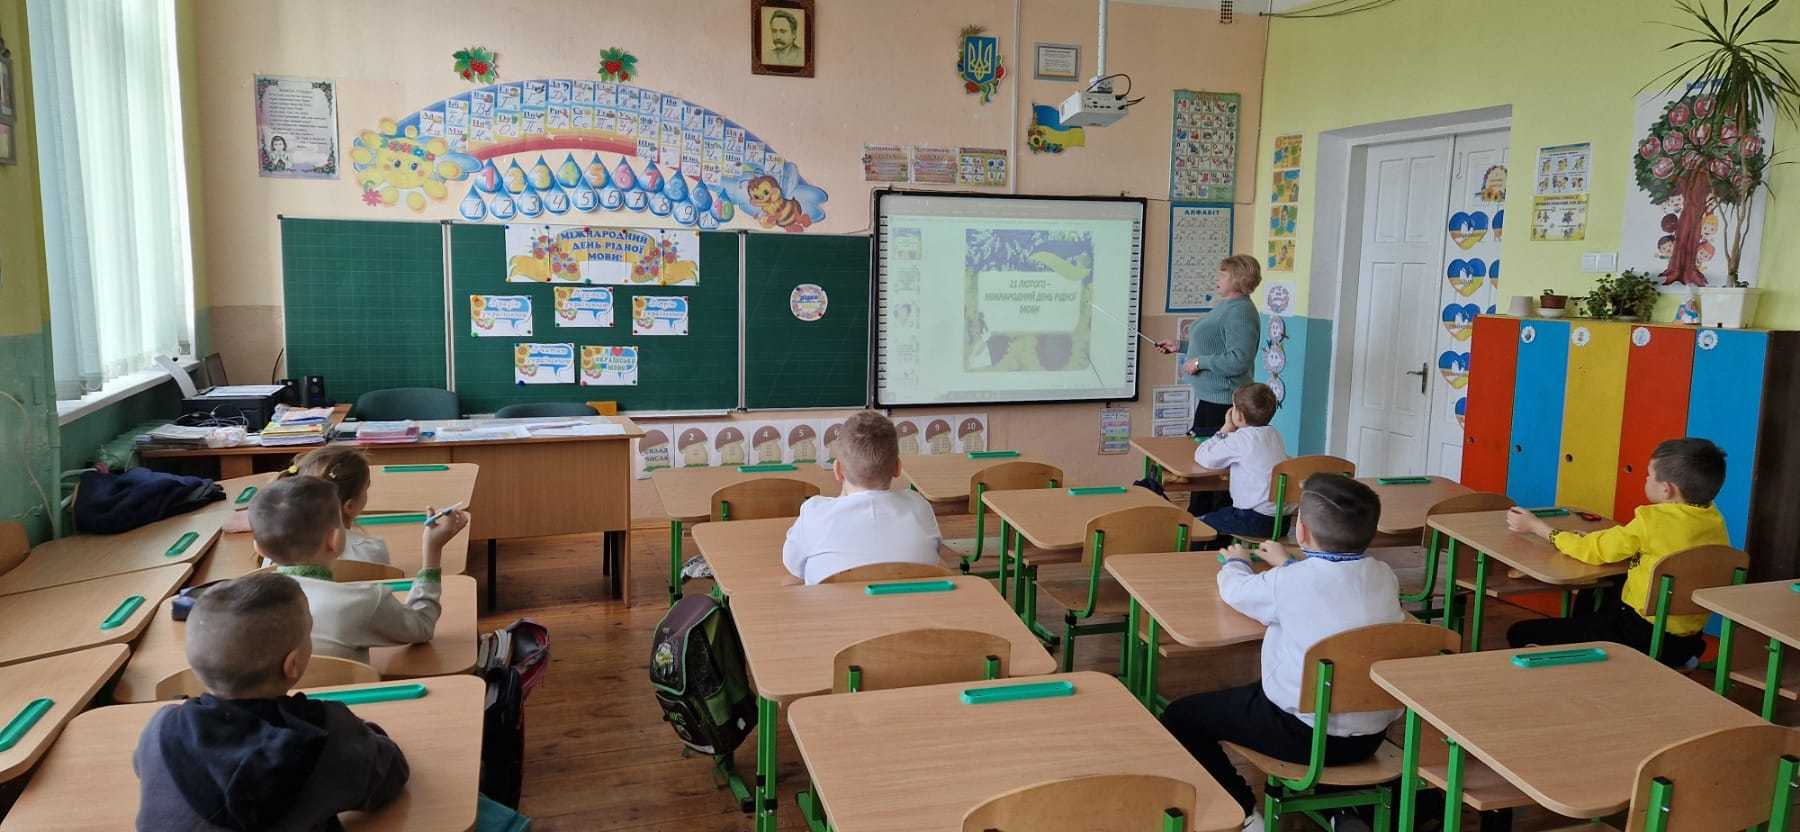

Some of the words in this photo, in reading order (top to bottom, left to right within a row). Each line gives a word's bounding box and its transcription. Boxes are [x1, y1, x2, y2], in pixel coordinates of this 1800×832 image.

[482, 168, 495, 190] 1
[511, 170, 522, 191] 2
[563, 163, 577, 185] 4
[591, 166, 604, 187] 5
[616, 168, 633, 188] 6
[645, 171, 658, 191] 7
[502, 200, 512, 214] 2
[528, 196, 538, 211] 3
[553, 196, 563, 208] 4
[582, 191, 593, 205] 5
[607, 191, 617, 204] 6
[633, 191, 644, 206] 7
[560, 230, 648, 244] МІЖНАРОДНИЙ
[573, 242, 601, 250] ДЕНЬ
[605, 242, 643, 253] РІДНОЇ
[588, 253, 623, 261] МОВИ!
[1009, 280, 1017, 288] 21
[1018, 280, 1046, 288] ЛЮТОГО
[967, 422, 975, 430] 10
